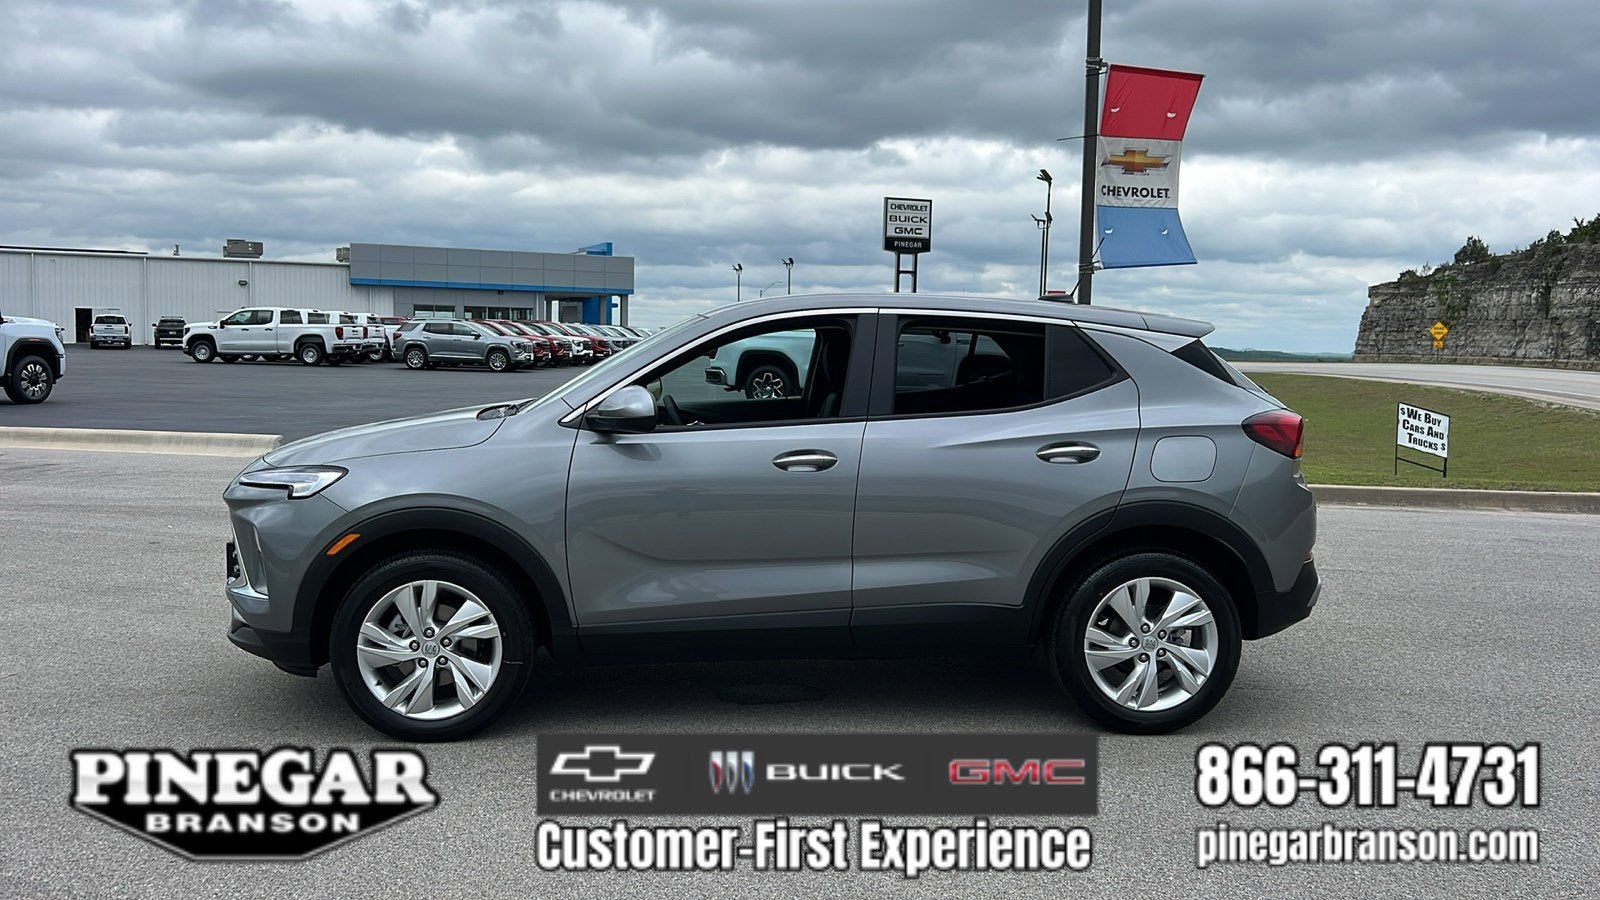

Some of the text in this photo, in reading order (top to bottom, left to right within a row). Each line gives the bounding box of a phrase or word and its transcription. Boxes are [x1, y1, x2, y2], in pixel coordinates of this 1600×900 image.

[1101, 184, 1170, 199] CHEVROLET
[890, 203, 928, 211] CHEVROLET
[889, 215, 928, 224] BUICK
[894, 227, 923, 235] GMC
[894, 240, 922, 248] PINEGAR
